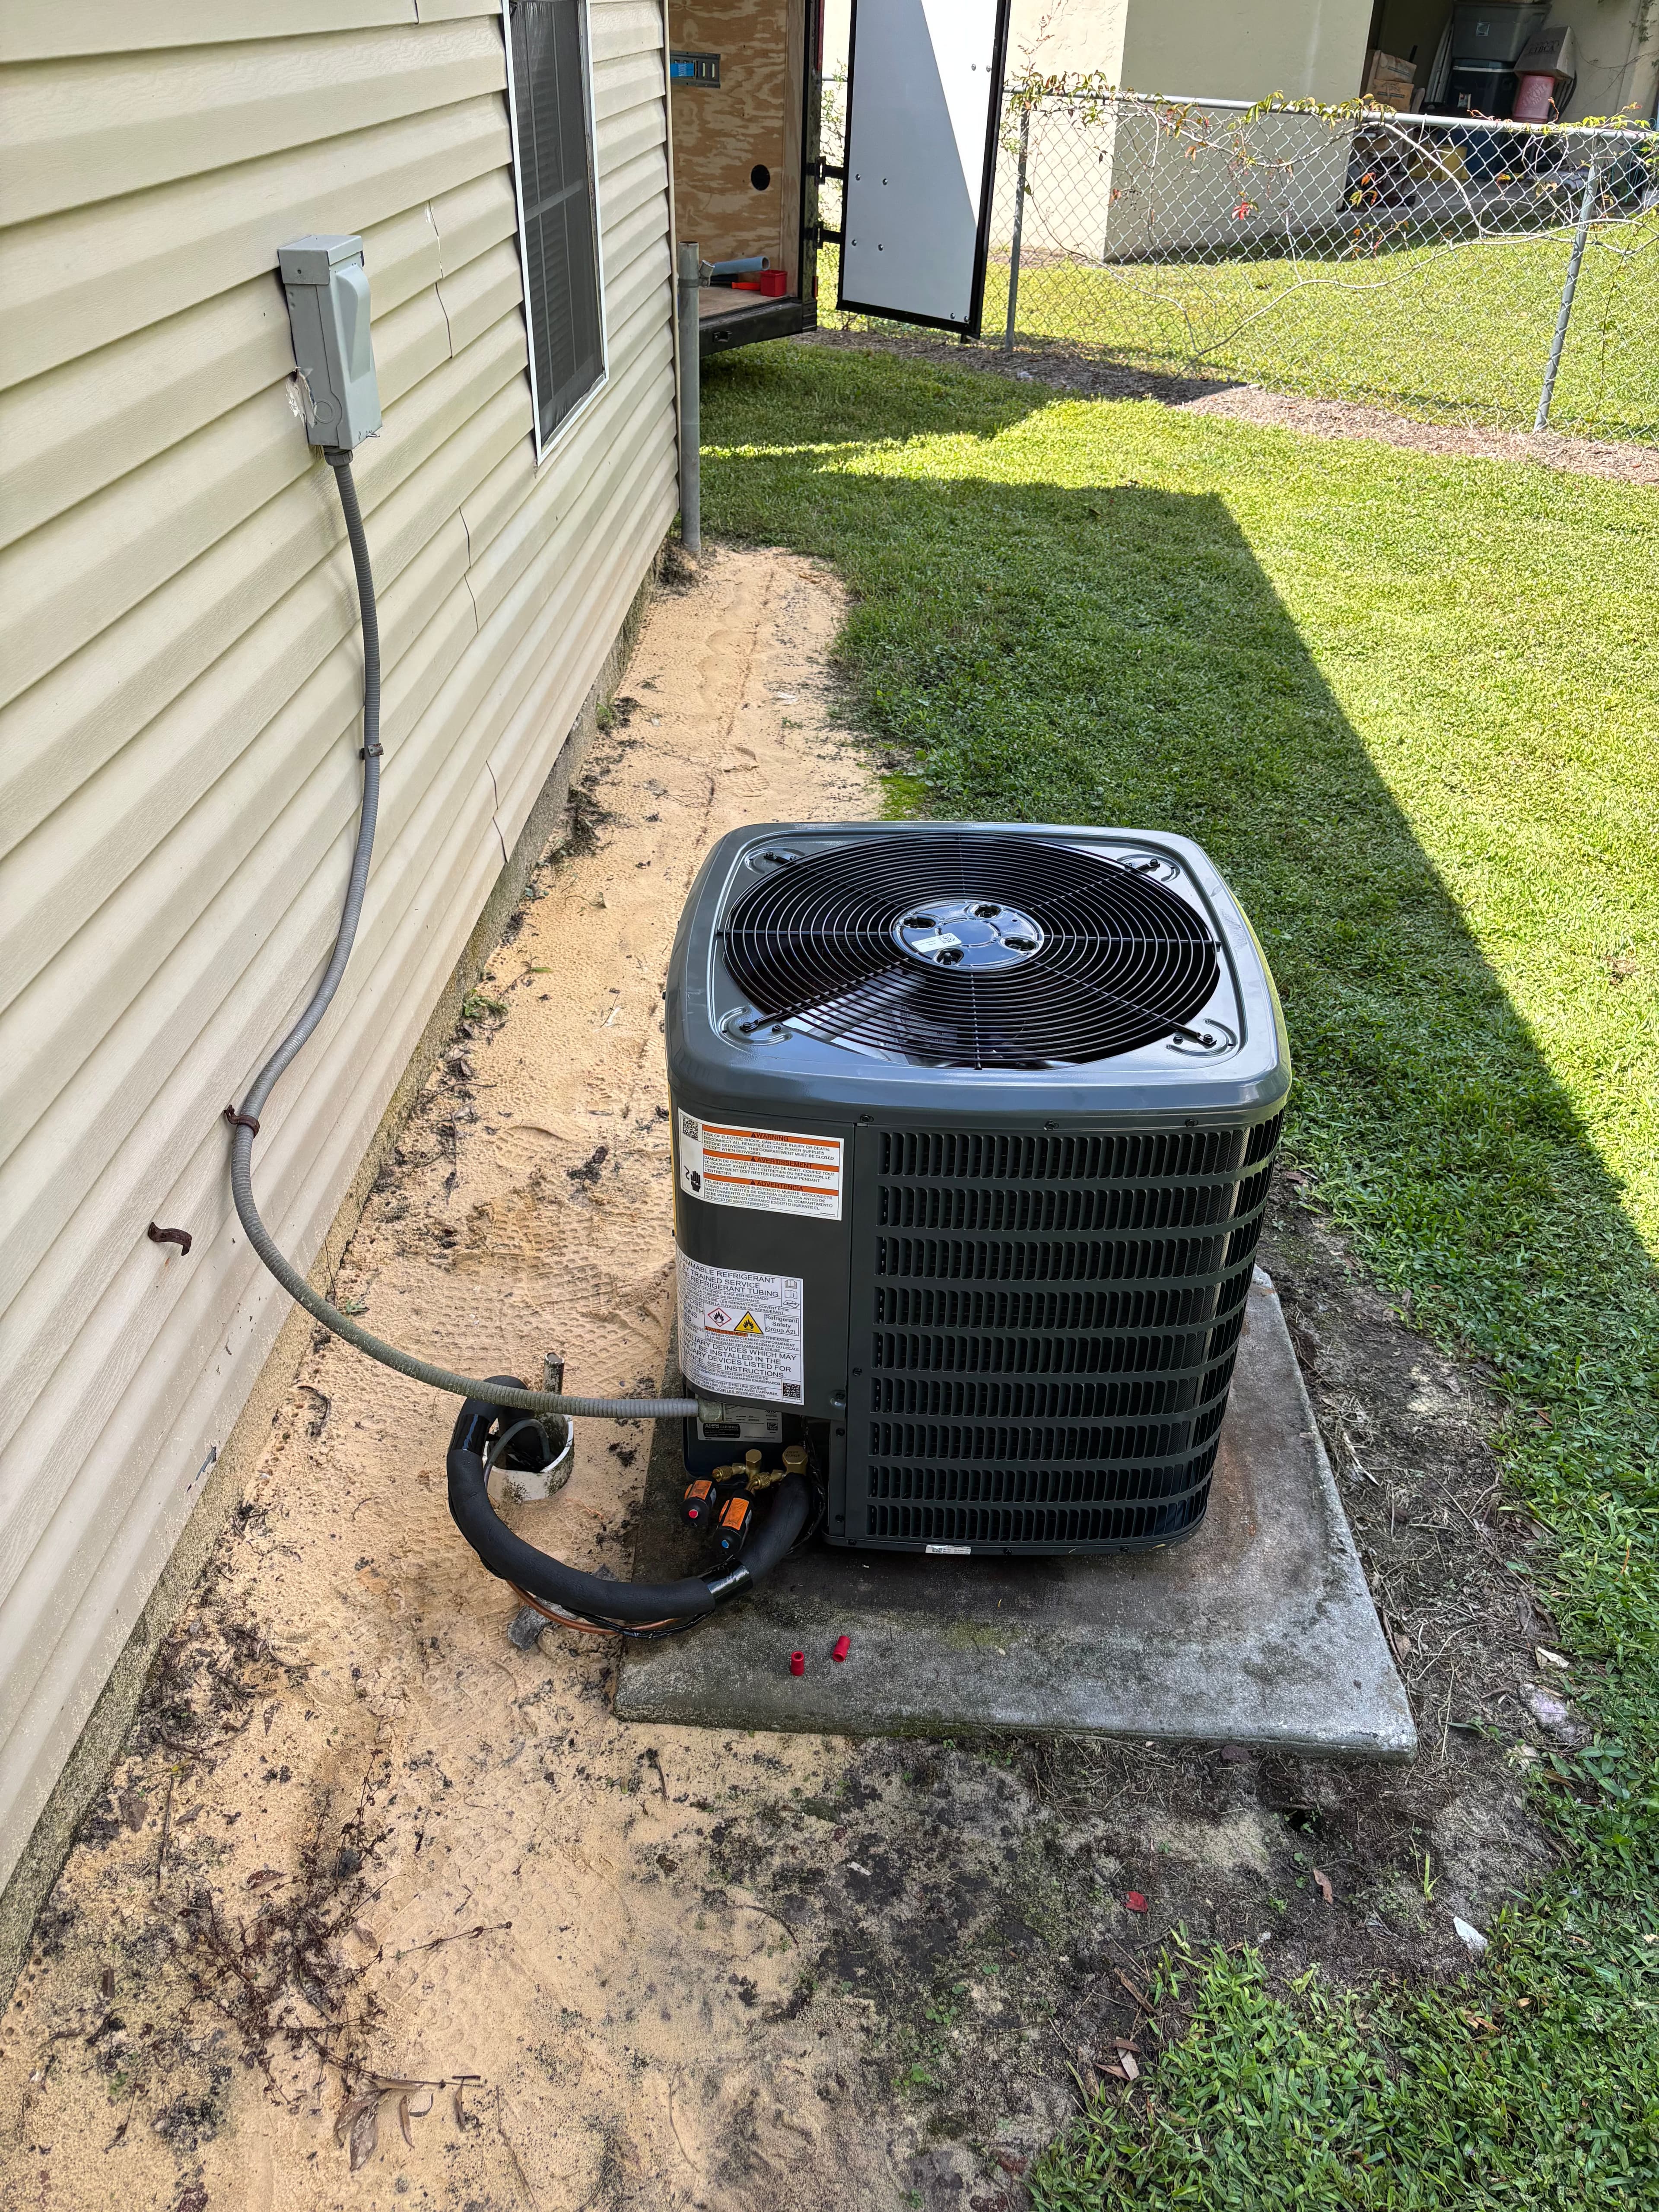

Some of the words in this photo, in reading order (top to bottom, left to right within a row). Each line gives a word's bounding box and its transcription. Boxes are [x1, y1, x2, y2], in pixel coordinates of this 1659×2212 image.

[756, 1133, 788, 1141] WARNING
[705, 1164, 738, 1173] COMPARTIMENT
[757, 1158, 811, 1168] AVERTISSEMENT
[706, 1187, 740, 1195] MANTENIMIENTO
[757, 1181, 804, 1191] ADVERTENCIA
[691, 1268, 722, 1284] TRAINED
[725, 1279, 760, 1288] SERVICE
[717, 1271, 775, 1283] REFRIGERANT
[691, 1275, 745, 1293] REFRIGERANT
[747, 1288, 779, 1297] TUBING
[687, 1302, 704, 1314] WITH
[772, 1322, 791, 1330] Safety
[710, 1349, 753, 1360] INSTALLED
[713, 1344, 747, 1354] DEVICES
[750, 1350, 777, 1358] WHICH
[708, 1354, 742, 1365] DEVICES
[744, 1361, 772, 1370] LISTED
[707, 1361, 722, 1370] SEE
[725, 1365, 786, 1378] INSTRUCTIONS.
